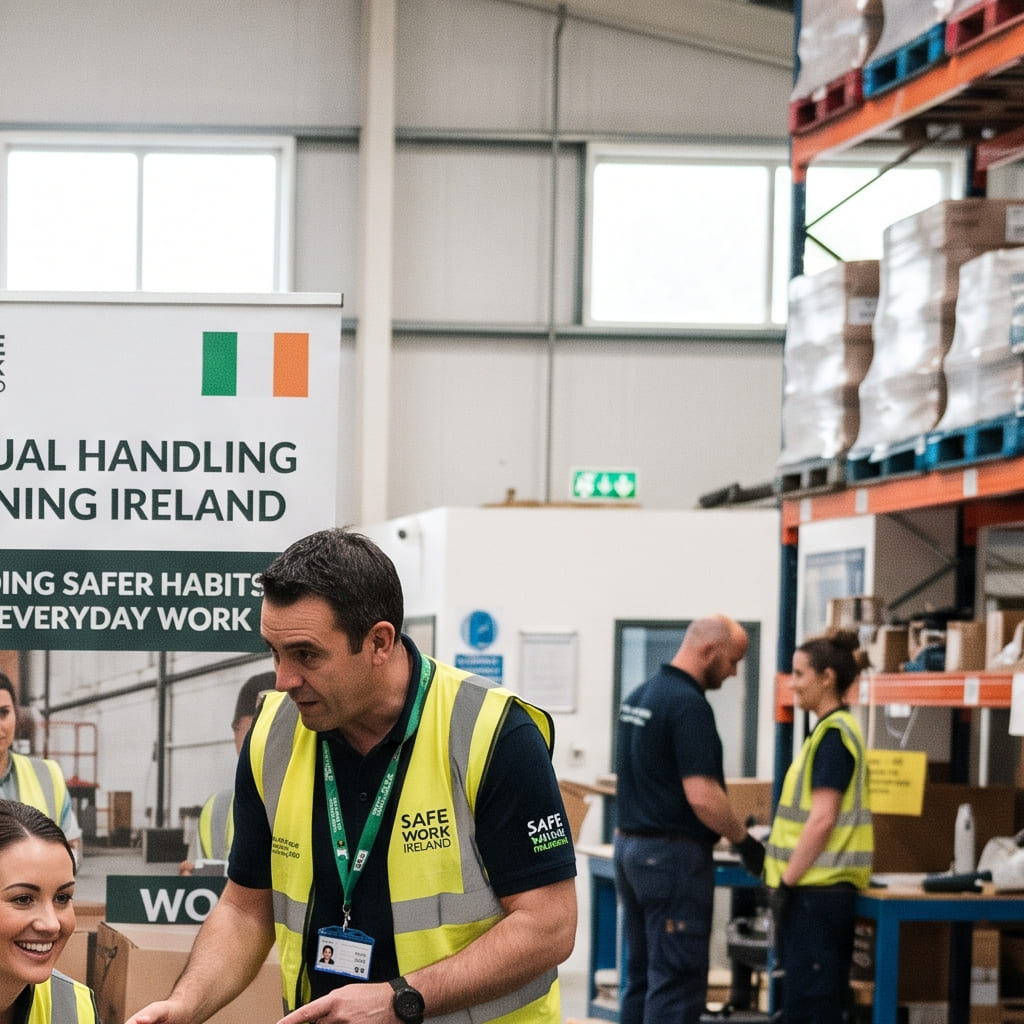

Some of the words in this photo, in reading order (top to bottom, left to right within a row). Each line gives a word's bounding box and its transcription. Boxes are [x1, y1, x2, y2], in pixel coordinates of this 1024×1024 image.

[78, 439, 297, 474] HANDLING
[110, 488, 287, 522] IRELAND
[62, 571, 154, 597] SAFER
[157, 607, 252, 632] WORK
[401, 808, 449, 829] SAFE
[527, 812, 563, 837] SAFE
[402, 825, 451, 842] WORK
[404, 838, 451, 853] IRELAND
